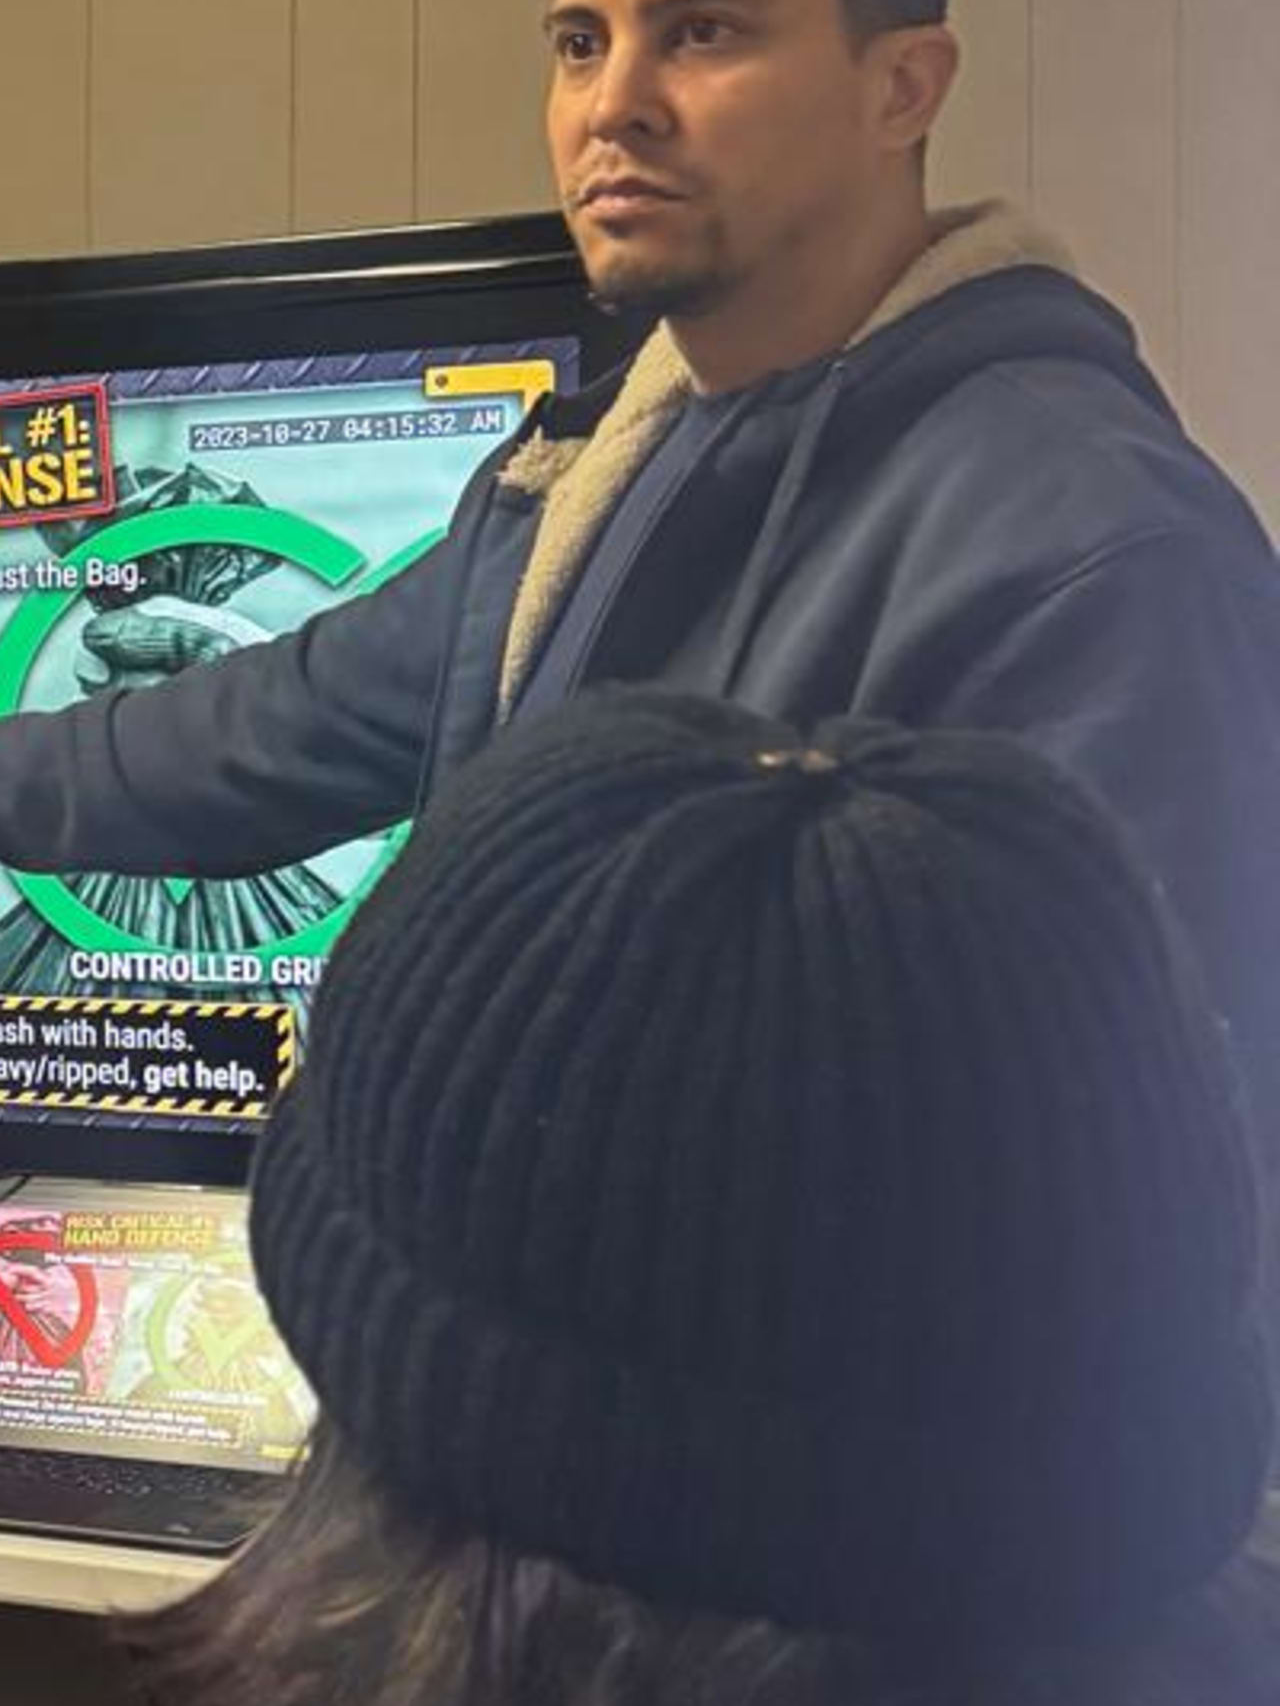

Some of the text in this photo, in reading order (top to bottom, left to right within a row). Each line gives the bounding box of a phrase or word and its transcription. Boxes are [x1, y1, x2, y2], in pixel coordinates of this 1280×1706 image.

[26, 404, 90, 447] #1:
[194, 410, 501, 449] 2023-10-27 04:15:32 AM
[36, 561, 77, 588] the
[86, 557, 147, 592] Bag.
[70, 950, 329, 985] CONTROLLED GRI
[40, 1018, 97, 1048] with
[104, 1020, 194, 1052] hands.
[143, 1063, 187, 1092] get
[194, 1061, 265, 1098] help.
